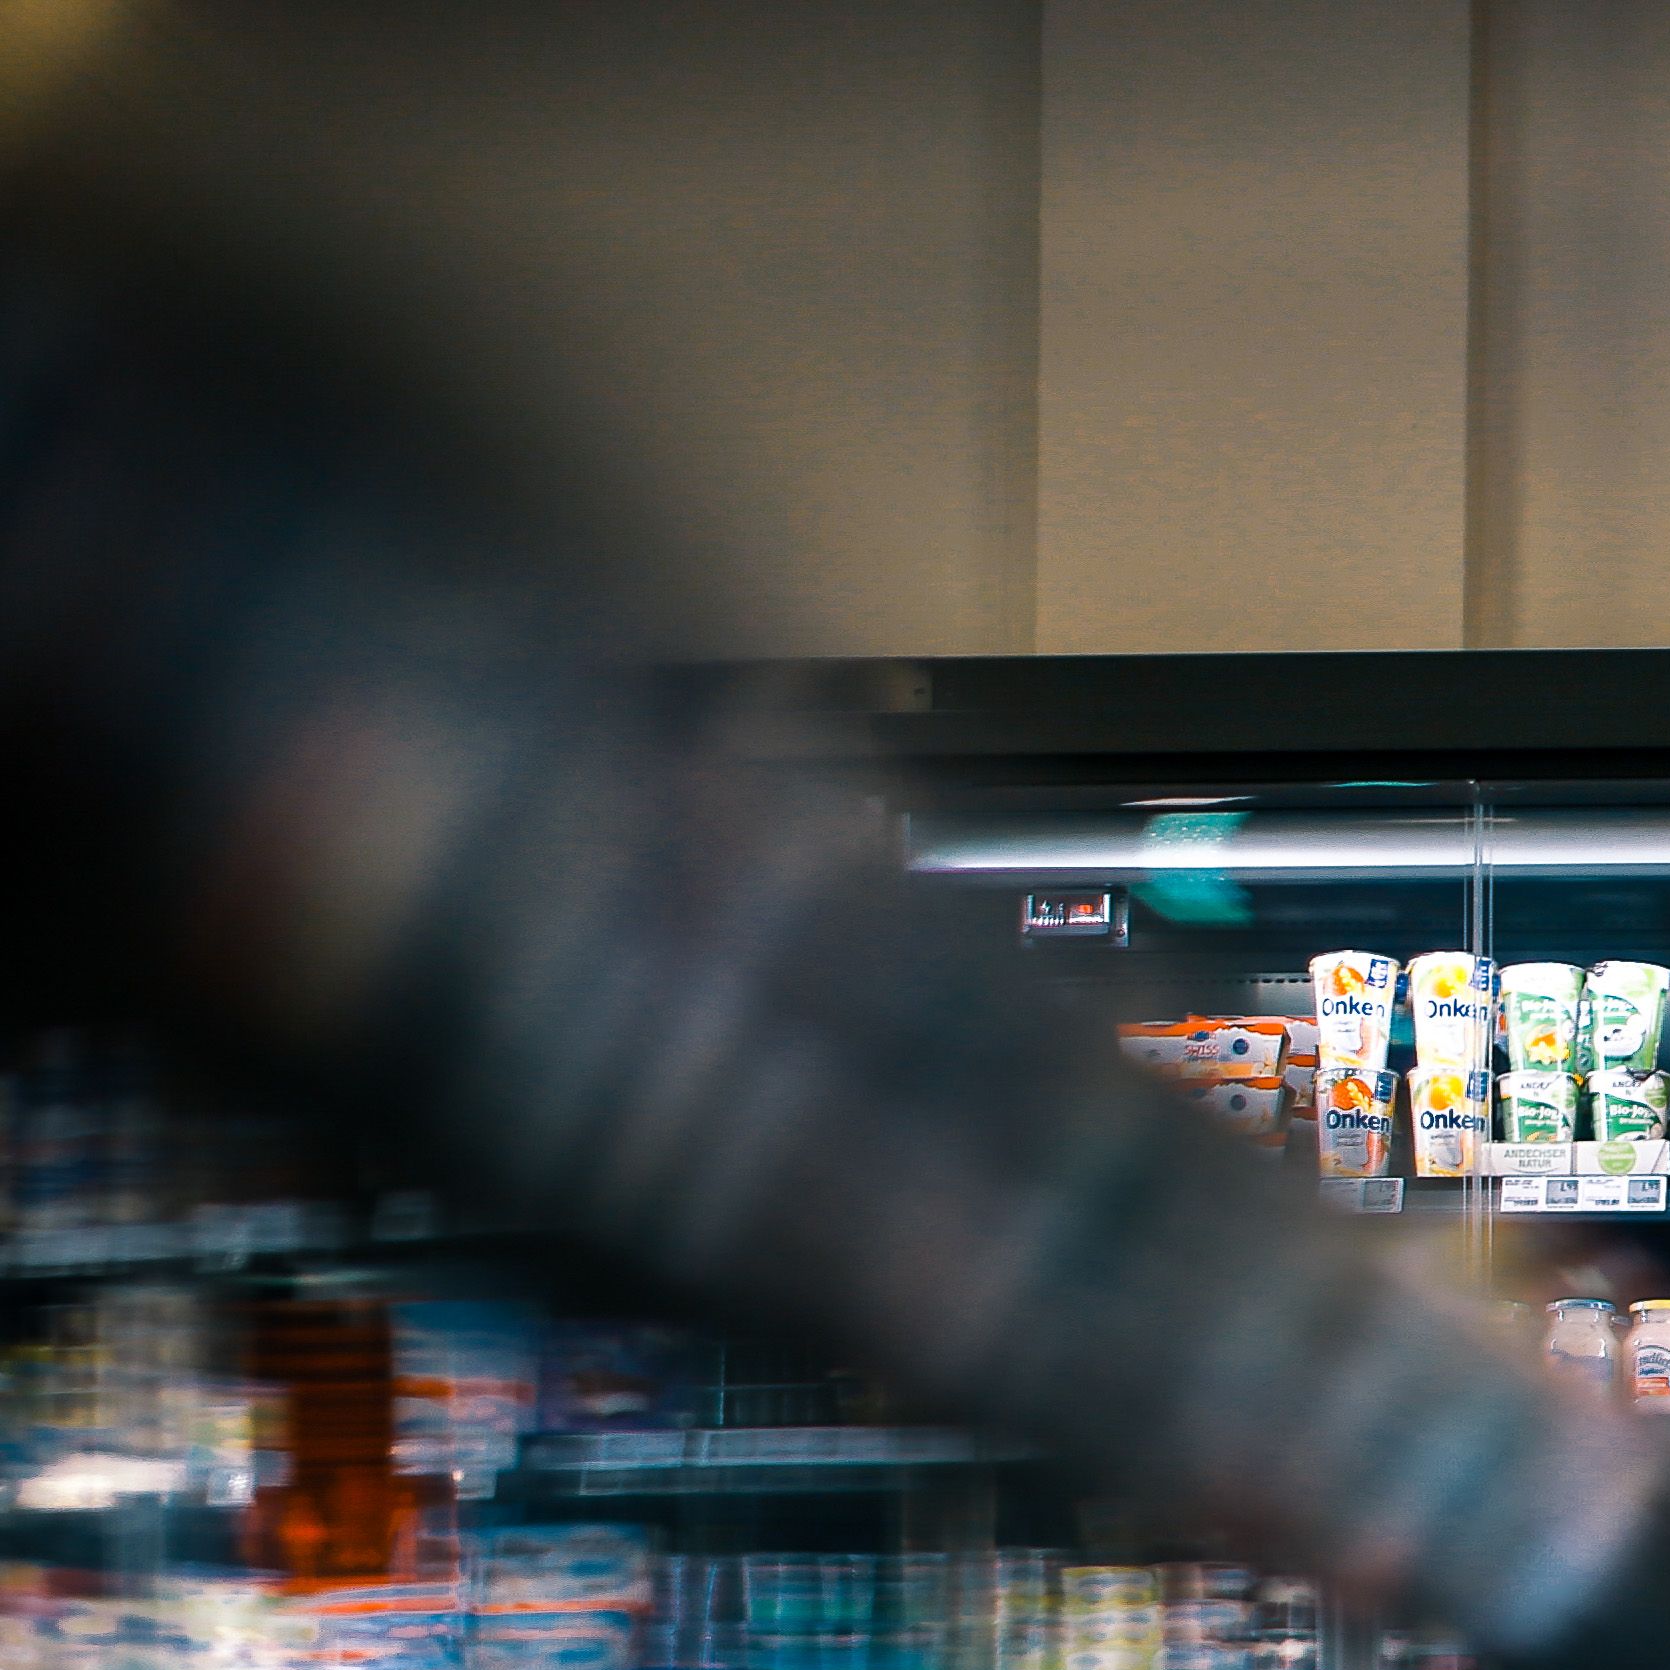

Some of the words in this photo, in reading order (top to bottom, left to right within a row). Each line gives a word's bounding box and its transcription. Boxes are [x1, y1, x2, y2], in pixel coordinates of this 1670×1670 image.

[1322, 995, 1385, 1017] Onken
[1326, 1108, 1392, 1131] Onken
[1420, 1109, 1486, 1132] Onken
[1504, 1147, 1566, 1159] ANDECHSER
[1519, 1158, 1553, 1169] NATUR
